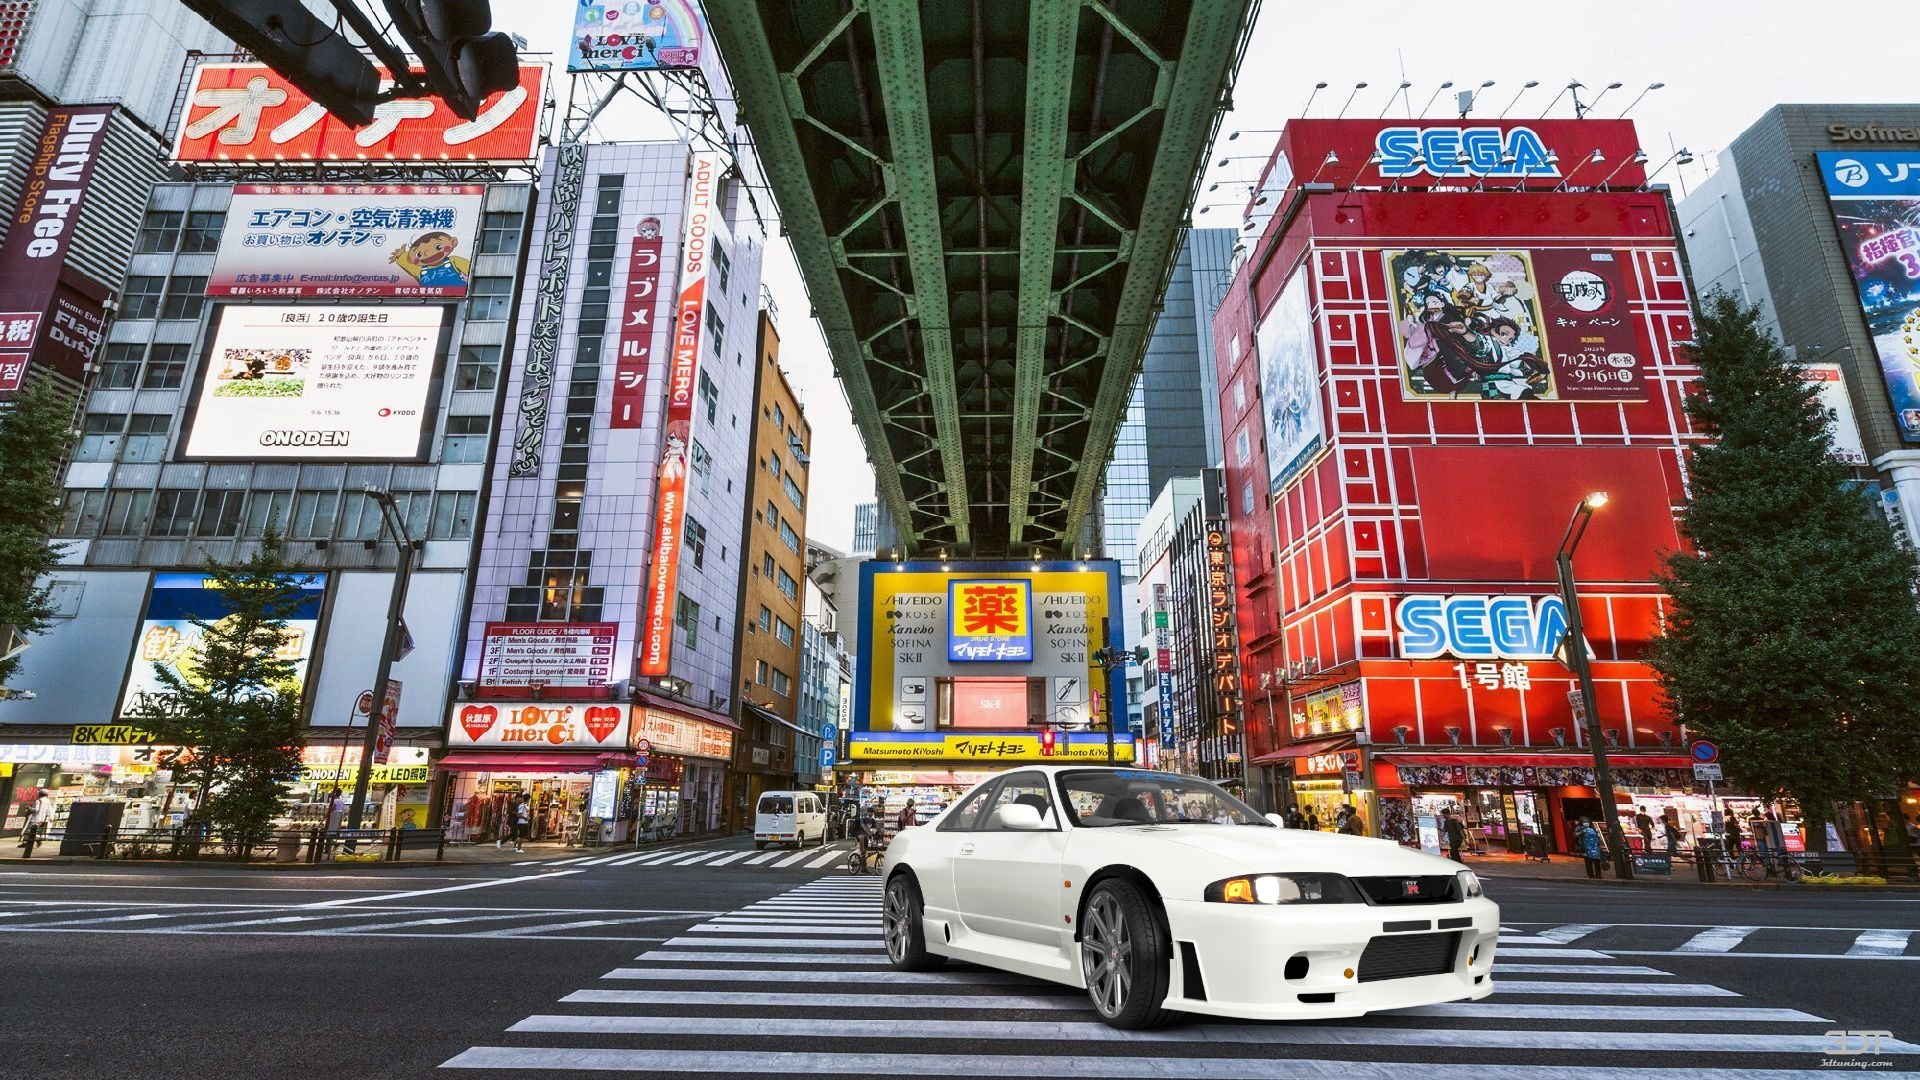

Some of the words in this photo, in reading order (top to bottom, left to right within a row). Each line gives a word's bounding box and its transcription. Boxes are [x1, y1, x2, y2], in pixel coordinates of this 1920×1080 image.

[596, 34, 645, 47] LOVE
[34, 114, 68, 176] Flagship
[49, 113, 107, 182] Duty
[1375, 126, 1563, 178] SEGA
[691, 159, 711, 209] ADULT
[19, 180, 45, 224] Store
[27, 189, 82, 258] Free
[249, 206, 456, 230] エアコン・空気清浄機
[243, 229, 387, 248] お買い物はオノデンで
[686, 213, 708, 273] GOODS
[235, 274, 295, 284] 広告募集中
[300, 274, 400, 285] E-mail:info@entas.jp
[316, 287, 381, 296] 株式会社オノデン
[59, 297, 84, 317] Home
[280, 313, 312, 324] 「良浜」
[679, 300, 699, 347] LOVE
[49, 326, 96, 358] Duty
[619, 248, 658, 421] ラブメルシー
[1557, 353, 1607, 368] 7月23日
[672, 349, 693, 407] MERCI
[260, 429, 350, 447] ONODEN
[649, 490, 677, 666] www.akibalovemerci.com
[881, 595, 942, 606] SHISEIDO
[1038, 595, 1101, 606] SHISEIDO
[905, 609, 937, 619] KOSÉ
[963, 585, 1019, 634] 薬
[512, 628, 535, 636] FLOOR
[537, 628, 558, 636] GUIDE
[888, 623, 935, 635] Kanebo
[1046, 623, 1095, 635] Kanebo
[1395, 594, 1597, 660] SEGA
[527, 636, 550, 644] Goods
[890, 638, 932, 648] SOFINA
[1050, 638, 1093, 648] SOFINA
[1210, 551, 1236, 734] 東京ラジオデパート
[526, 647, 548, 655] Goods
[899, 652, 923, 663] SK-II
[953, 641, 1028, 661] マツモトキヨシ
[1060, 652, 1085, 663] SK-II
[488, 657, 498, 665] 2F
[503, 667, 534, 675] Costume
[1452, 662, 1532, 691] 1号館
[465, 713, 492, 724] 秋葉原
[510, 706, 570, 726] LOVE
[75, 727, 102, 743] 8K
[104, 727, 128, 743] 4K
[863, 746, 911, 756] Matsumoto
[955, 739, 1027, 757] マツモトキヨシ
[390, 767, 428, 781] LED照明
